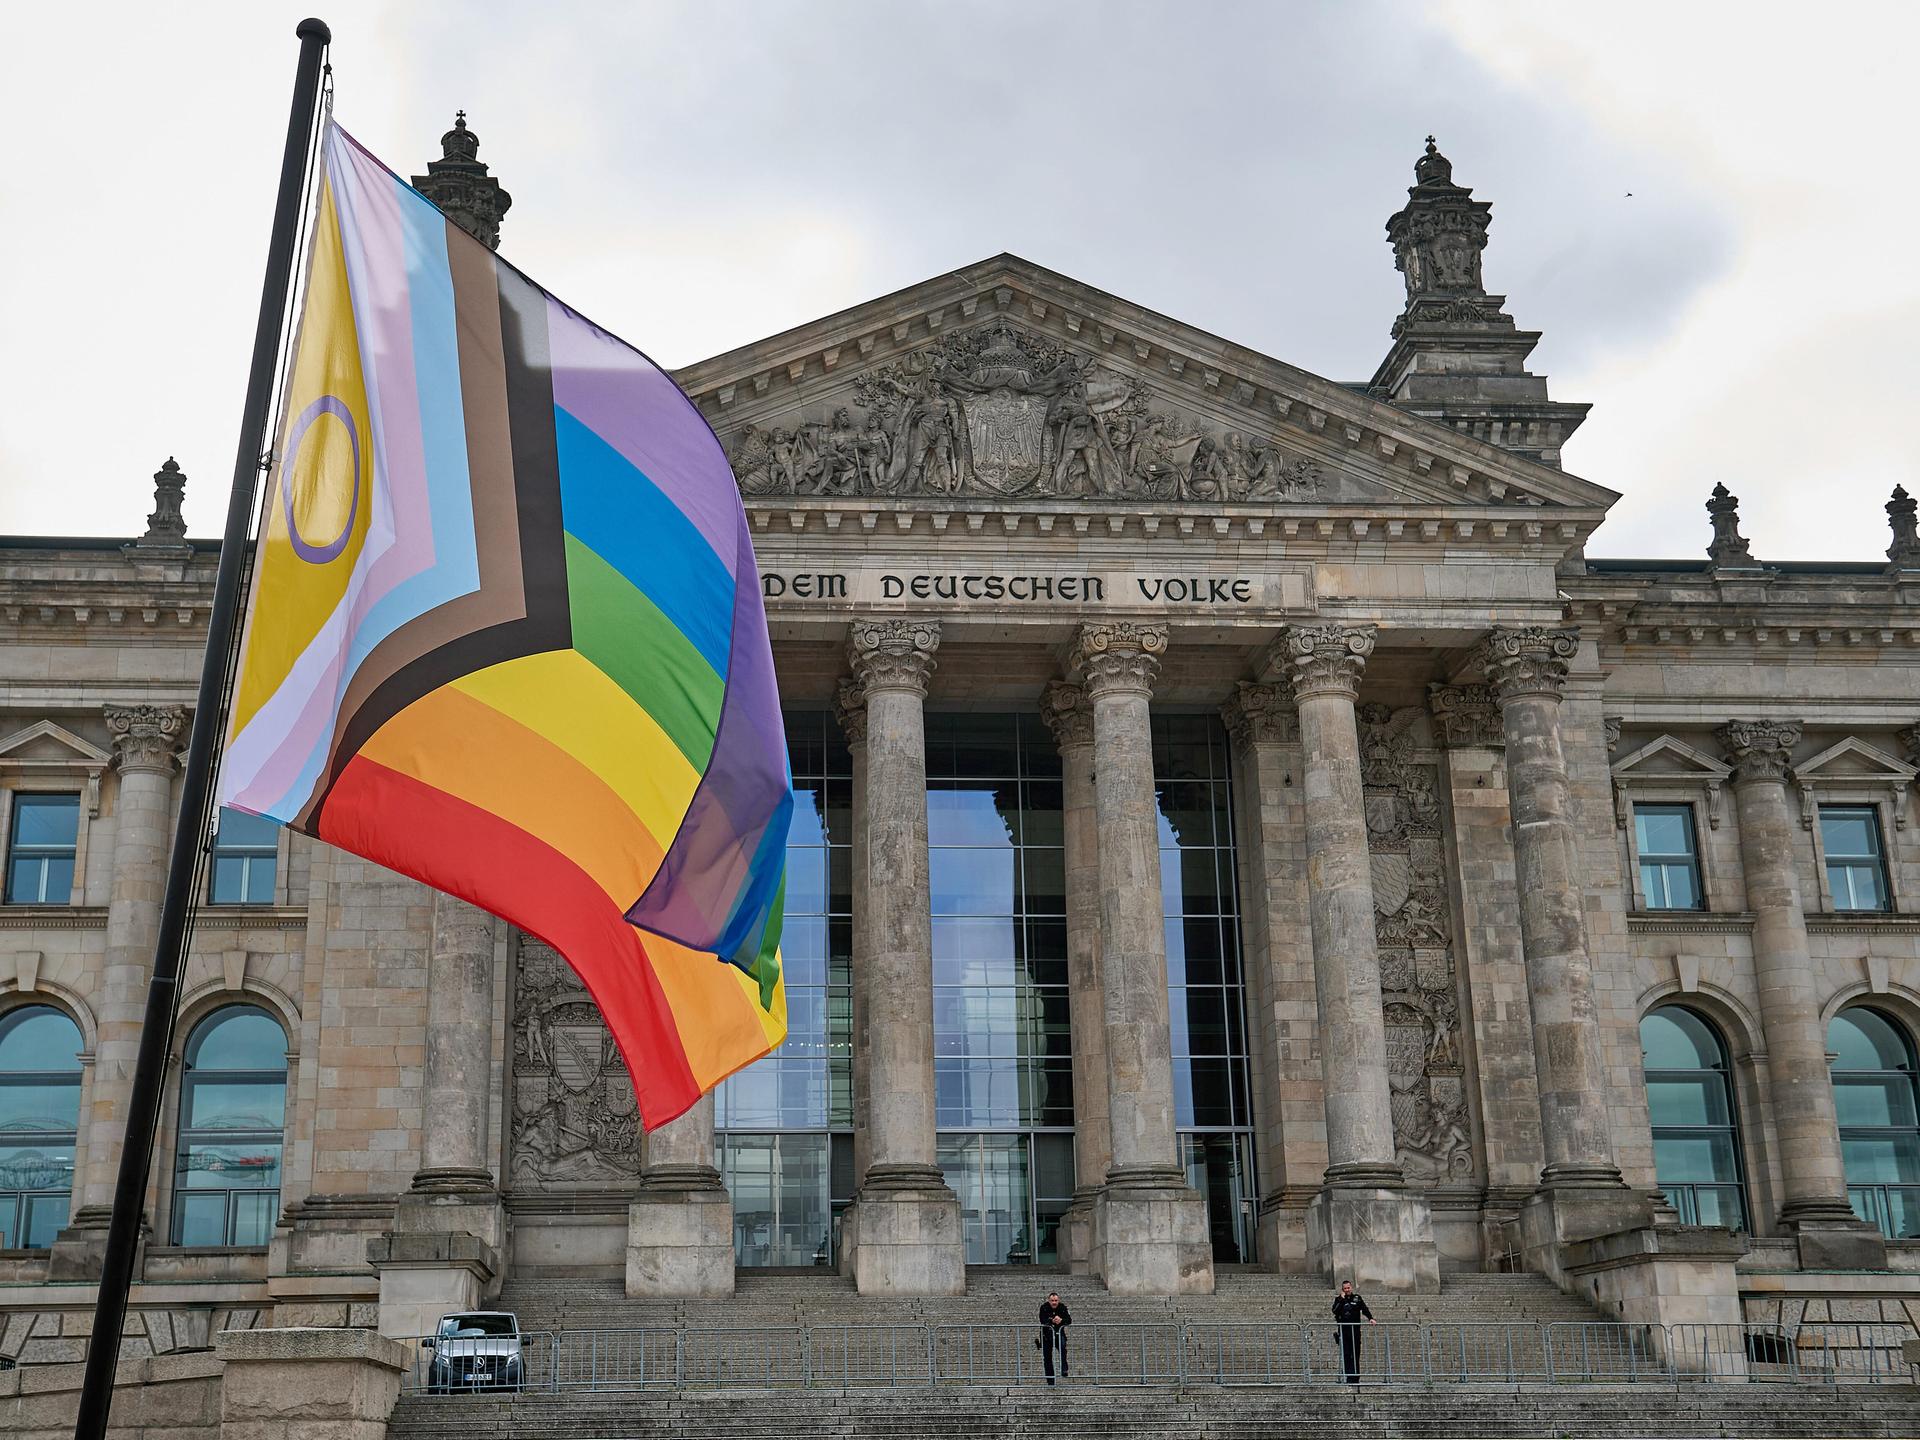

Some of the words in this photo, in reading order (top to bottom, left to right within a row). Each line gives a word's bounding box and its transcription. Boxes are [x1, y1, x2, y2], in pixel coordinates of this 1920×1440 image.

[761, 573, 848, 599] DEM
[880, 575, 1104, 602] DEUTSCHEN
[1138, 578, 1252, 604] VOLKE
